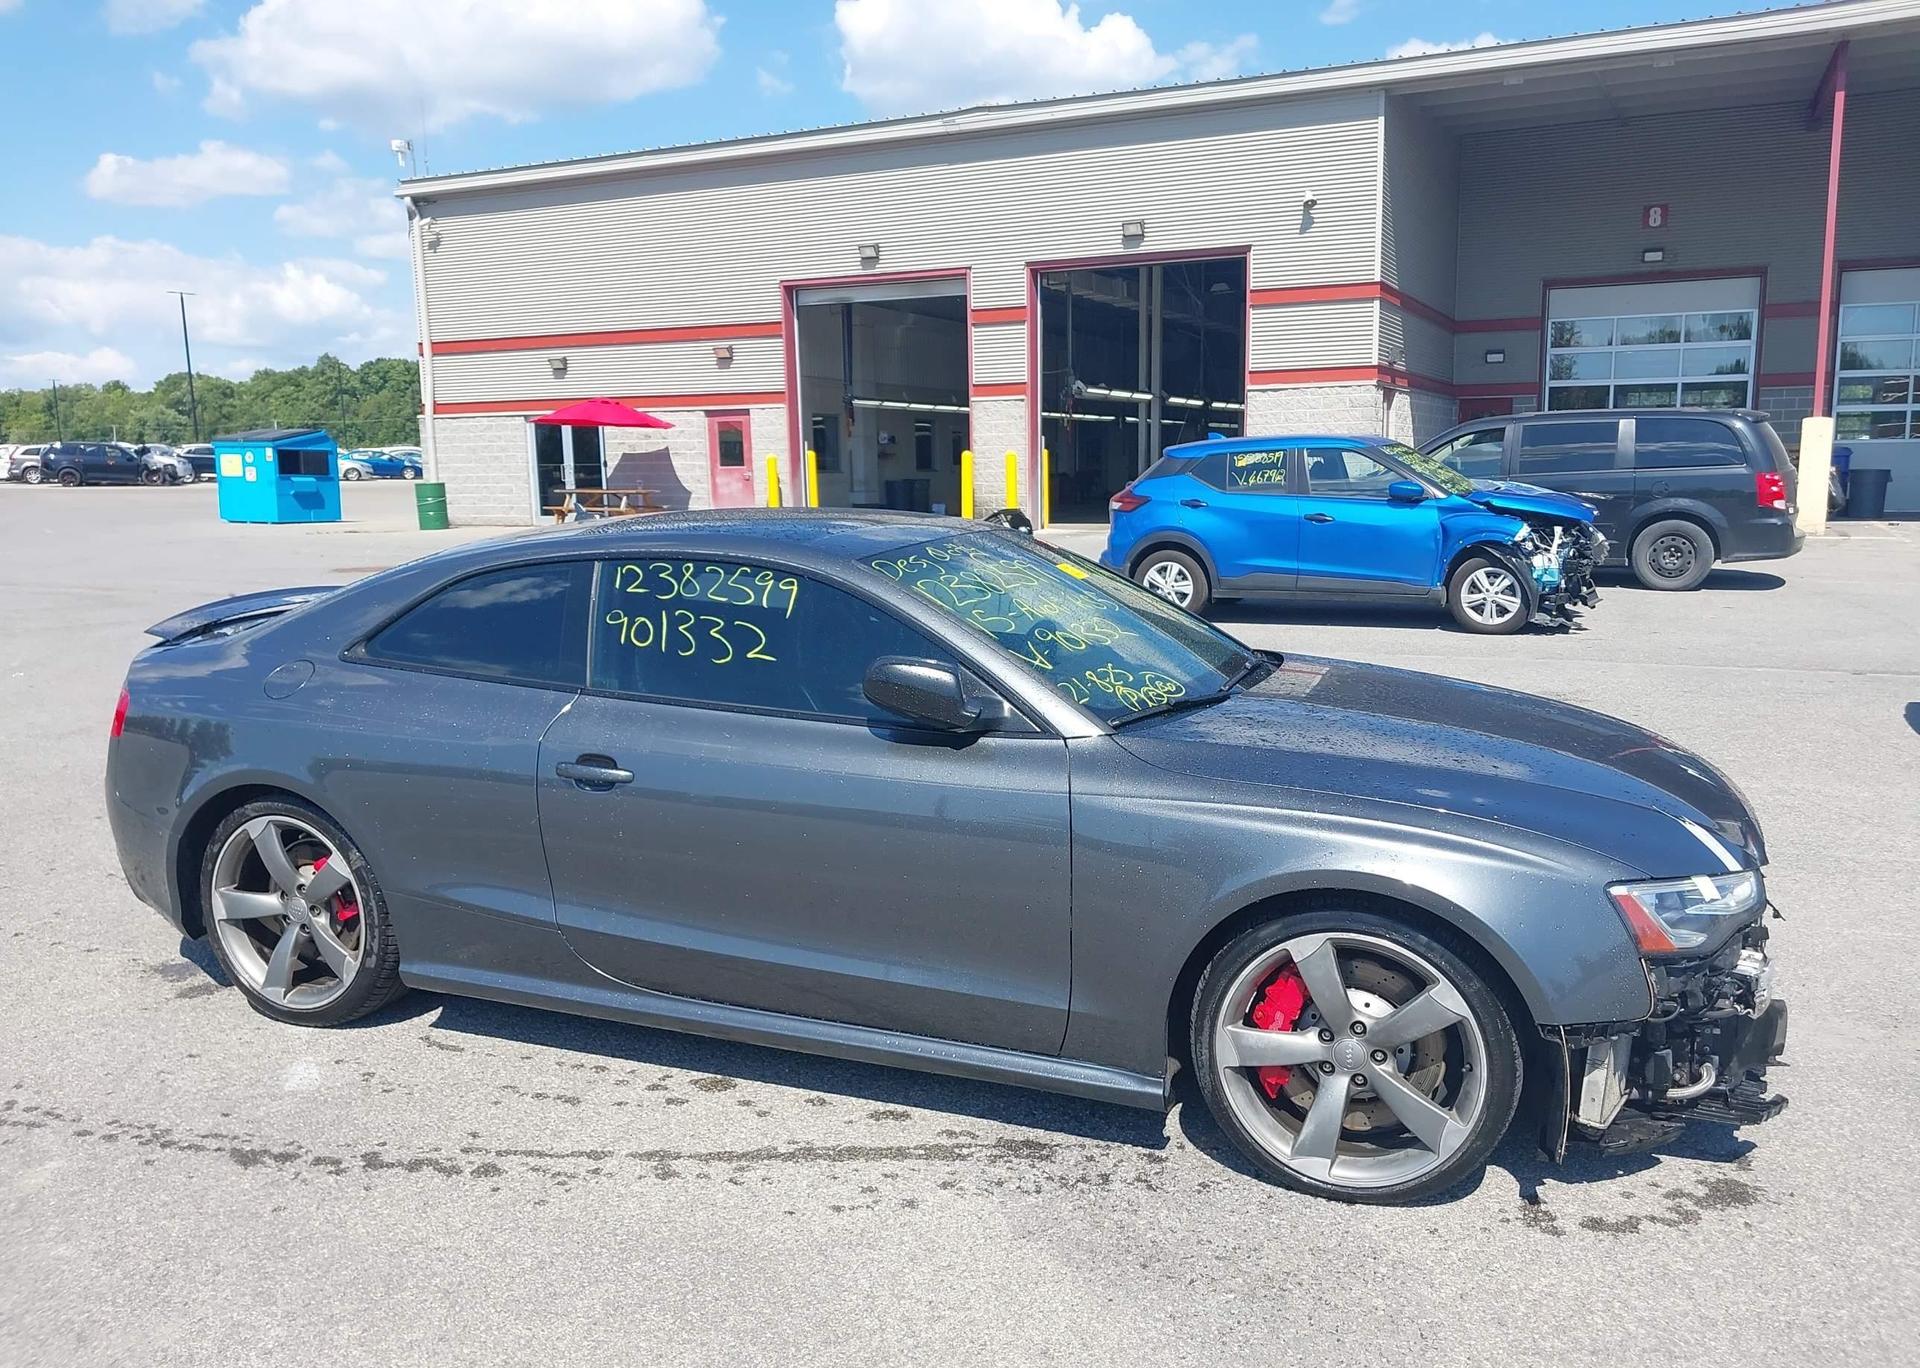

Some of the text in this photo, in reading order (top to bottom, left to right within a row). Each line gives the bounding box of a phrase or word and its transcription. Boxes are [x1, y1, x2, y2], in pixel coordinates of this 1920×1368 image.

[1649, 207, 1661, 227] 8
[614, 562, 799, 619] 12382599
[606, 609, 777, 663] 901332
